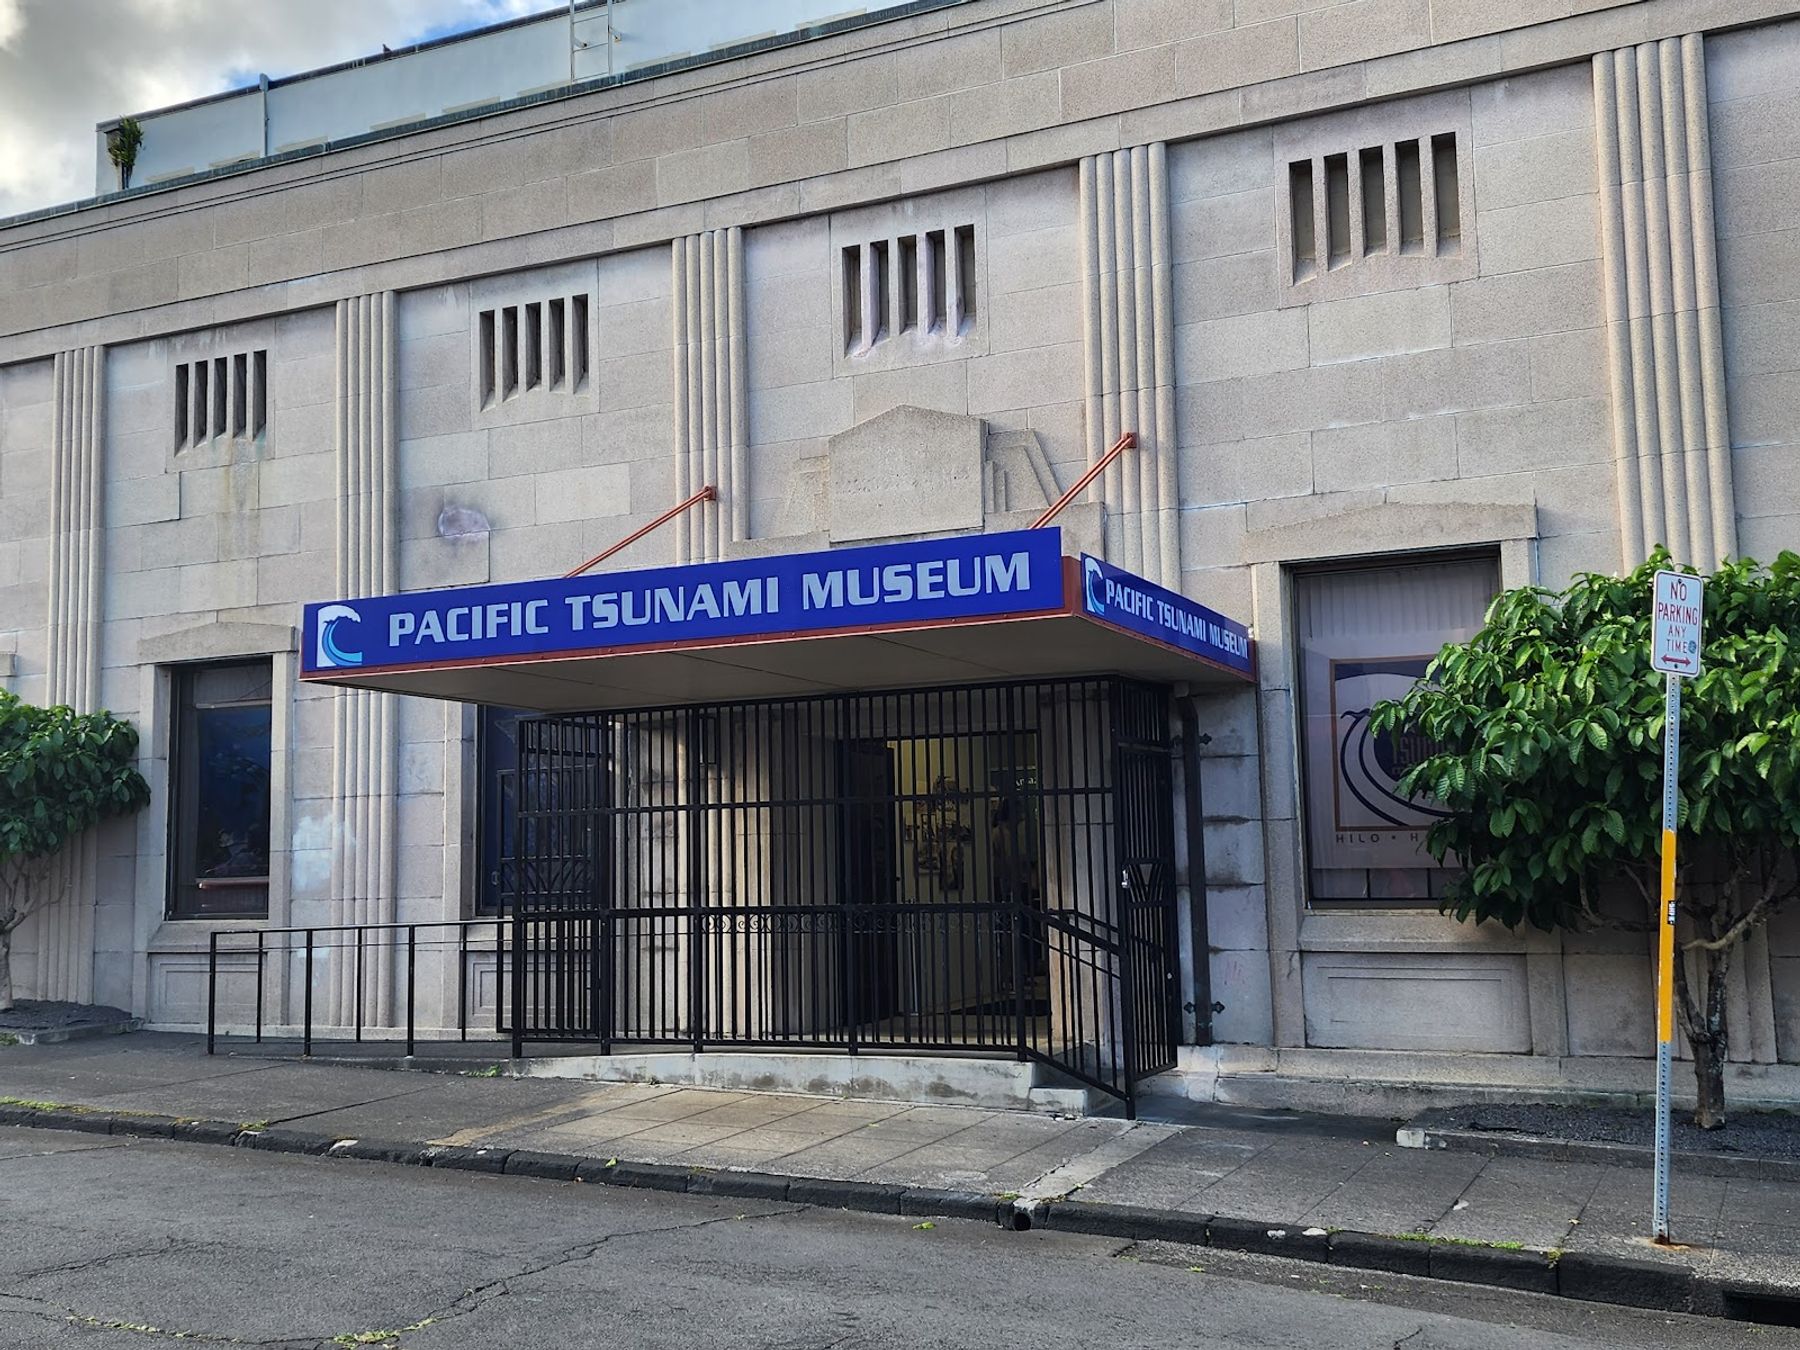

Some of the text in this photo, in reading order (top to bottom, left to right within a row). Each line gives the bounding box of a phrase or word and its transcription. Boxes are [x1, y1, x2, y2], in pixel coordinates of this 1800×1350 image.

[388, 551, 1030, 647] PACIFIC TSUNAMI MUSEUM
[1670, 581, 1687, 601] NO
[1105, 578, 1248, 660] PACIFIC TSUNAMI MUSEUM
[1658, 602, 1698, 626] PARKING
[1668, 625, 1687, 639] ANY
[1666, 638, 1688, 654] TIME
[1336, 833, 1380, 843] HILO
